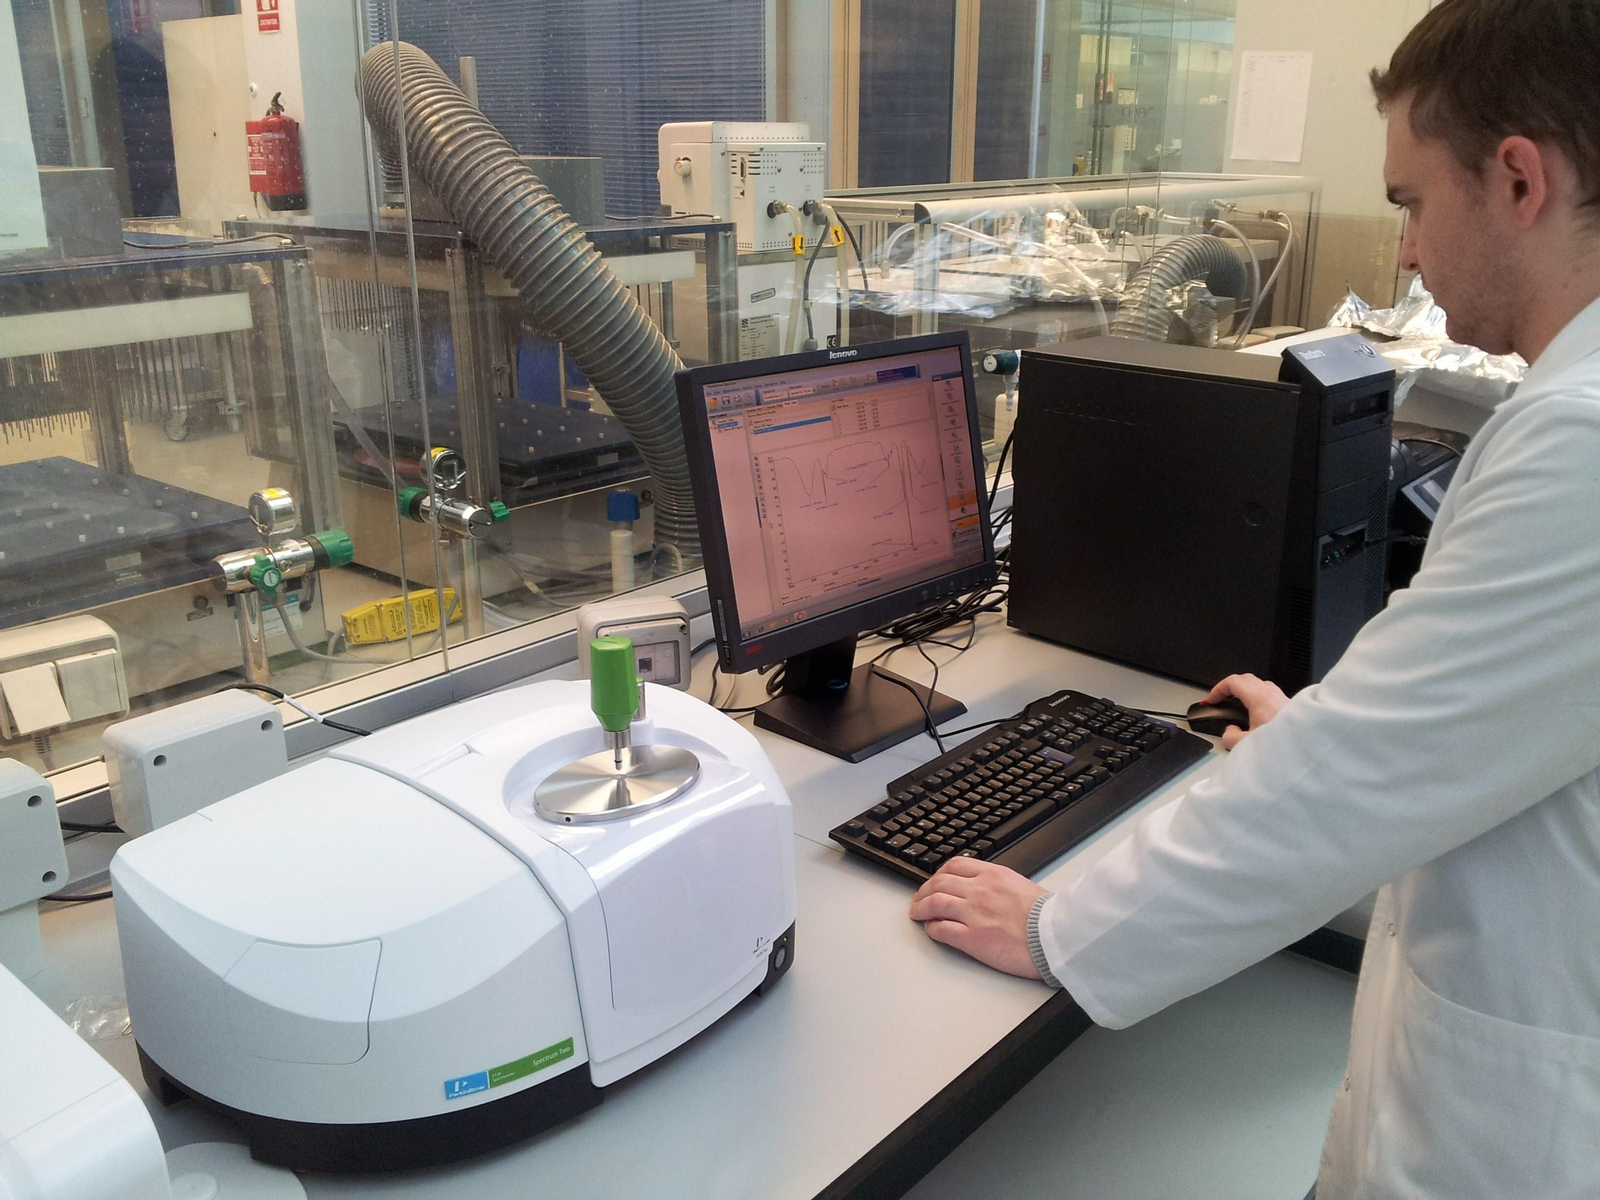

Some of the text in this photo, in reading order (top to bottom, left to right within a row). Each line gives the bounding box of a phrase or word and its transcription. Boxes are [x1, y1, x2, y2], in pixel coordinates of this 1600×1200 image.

[829, 349, 858, 360] lenovo
[1049, 694, 1071, 707] lenovo
[532, 1045, 571, 1067] Spectrum Two
[448, 1084, 486, 1099] PerkinElmer
